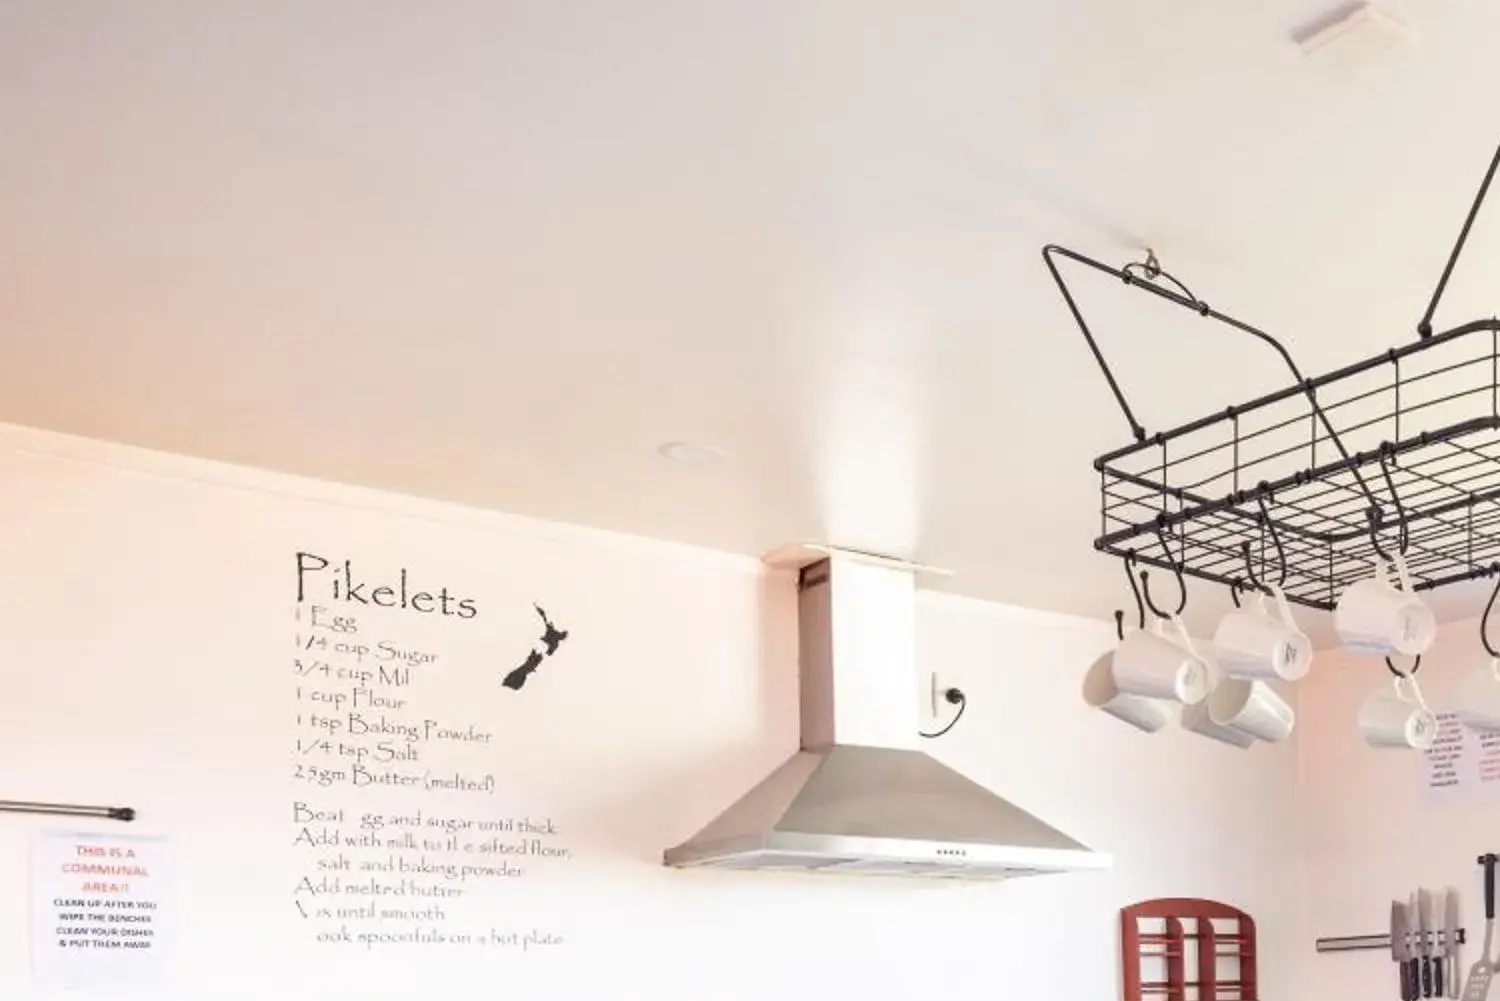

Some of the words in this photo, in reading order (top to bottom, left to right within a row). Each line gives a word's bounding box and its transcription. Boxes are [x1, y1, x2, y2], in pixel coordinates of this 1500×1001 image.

[296, 552, 477, 619] Pikelets
[311, 604, 358, 632] Egg
[335, 643, 370, 662] cup
[374, 640, 439, 666] Sugar
[337, 667, 373, 687] cup
[311, 690, 347, 710] cup
[353, 687, 407, 709] Flour
[311, 714, 342, 736] tsp
[348, 712, 419, 742] Baking
[424, 719, 494, 743] Powder
[297, 739, 333, 755] 1/4
[339, 742, 369, 763] tsp
[374, 741, 419, 762] Salt
[352, 763, 418, 787] Butter
[388, 808, 421, 826] and
[427, 816, 478, 833] sugar
[478, 818, 513, 832] until
[517, 816, 559, 834] thick
[73, 844, 105, 858] THIS
[109, 846, 122, 859] IS
[125, 847, 136, 858] A
[292, 827, 339, 848] Add
[344, 830, 381, 847] with
[387, 832, 419, 849] milk
[423, 838, 442, 851] to
[479, 837, 527, 855] sifted
[61, 863, 150, 878] COMMUNAL
[317, 854, 351, 871] salt
[359, 854, 394, 872] and
[399, 855, 459, 880] baking
[461, 860, 523, 882] powder
[292, 876, 340, 896] Add
[345, 877, 406, 896] melted
[53, 898, 85, 907] CLEAN
[87, 899, 102, 908] UP
[104, 899, 134, 909] AFTER
[337, 901, 375, 919] until
[380, 904, 445, 920] smooth
[58, 913, 84, 921] WIPE
[87, 913, 105, 922] THE
[56, 926, 88, 935] CLEAN
[449, 934, 472, 946] on
[523, 929, 564, 952] plate
[69, 939, 90, 948] PUT
[92, 939, 120, 949] THEM
